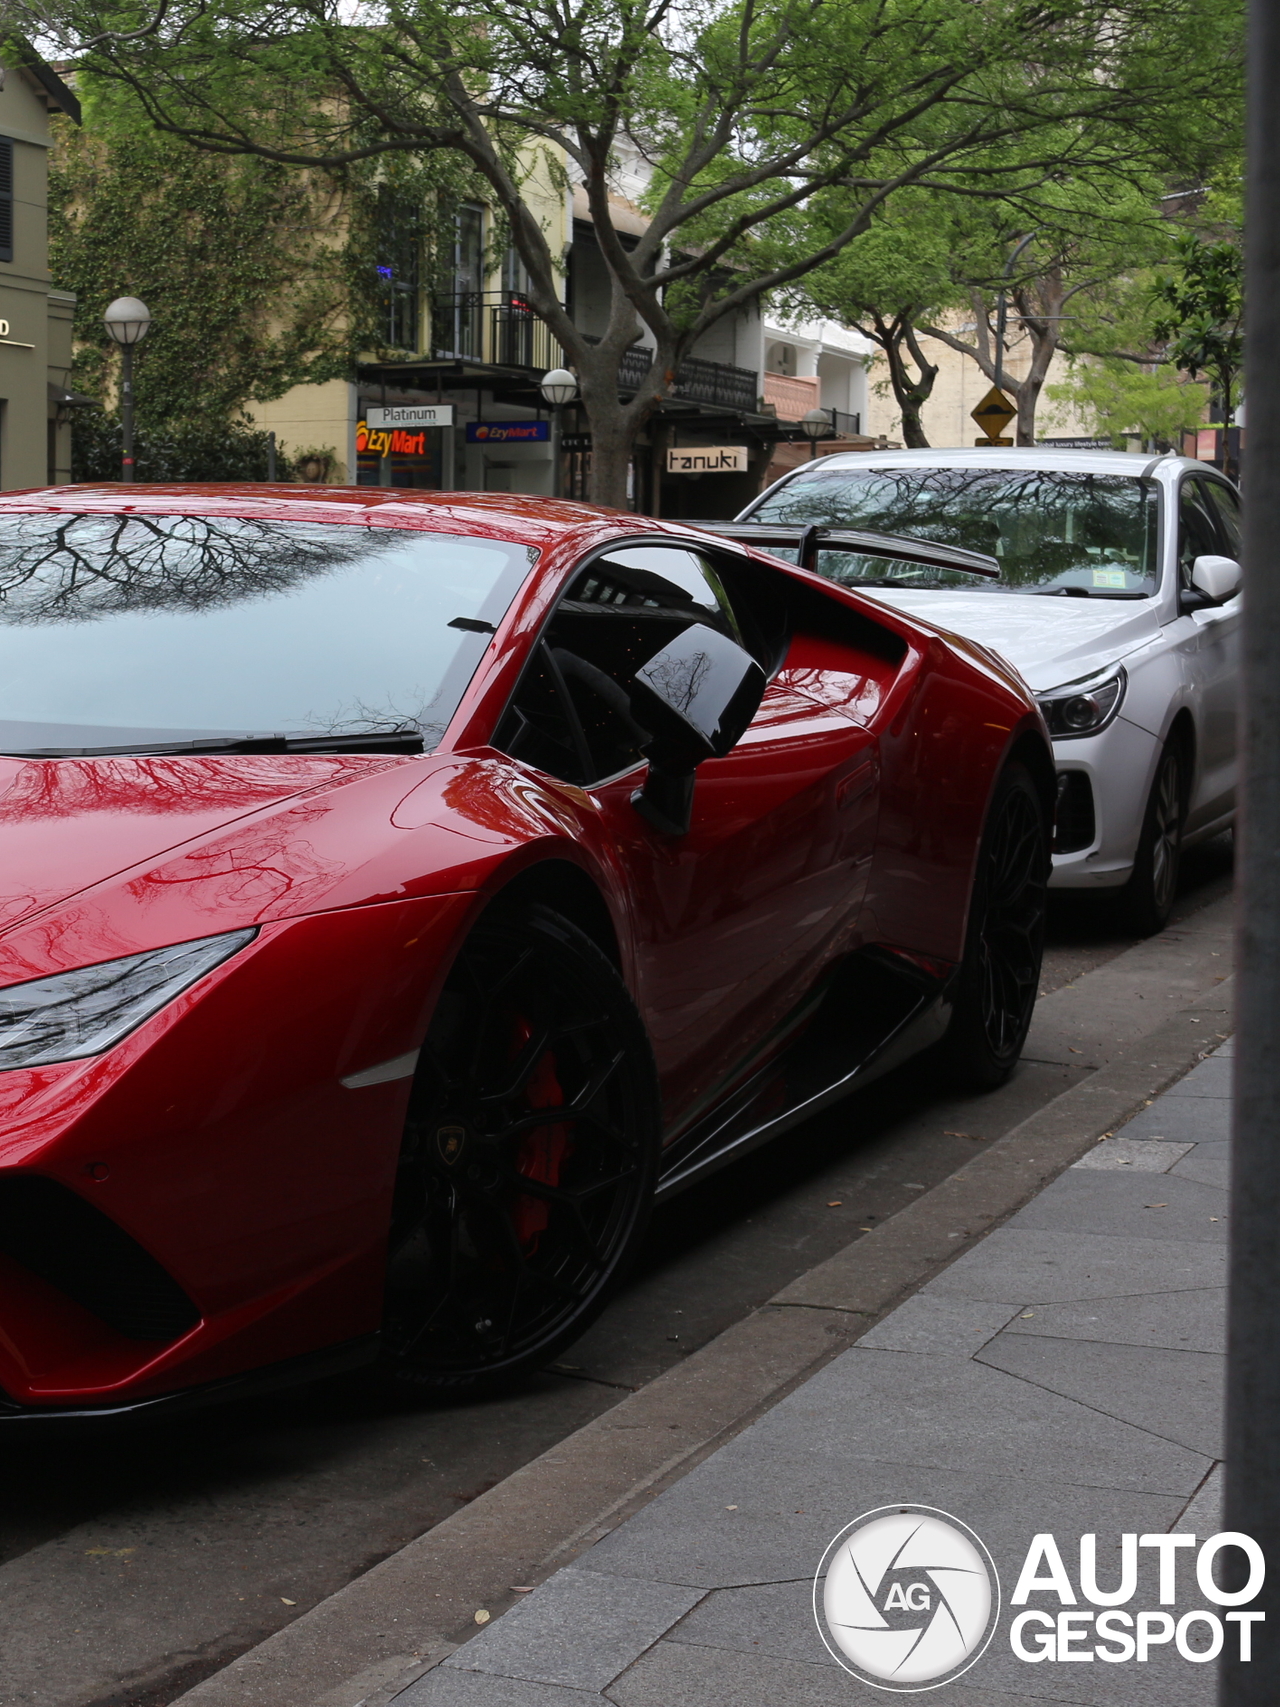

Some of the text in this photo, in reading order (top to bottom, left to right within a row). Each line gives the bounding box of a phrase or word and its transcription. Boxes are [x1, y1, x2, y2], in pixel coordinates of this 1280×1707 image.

[382, 408, 436, 422] Platinum
[489, 426, 538, 440] EzyMart
[368, 429, 425, 458] EzyMart
[670, 450, 737, 470] tanuki
